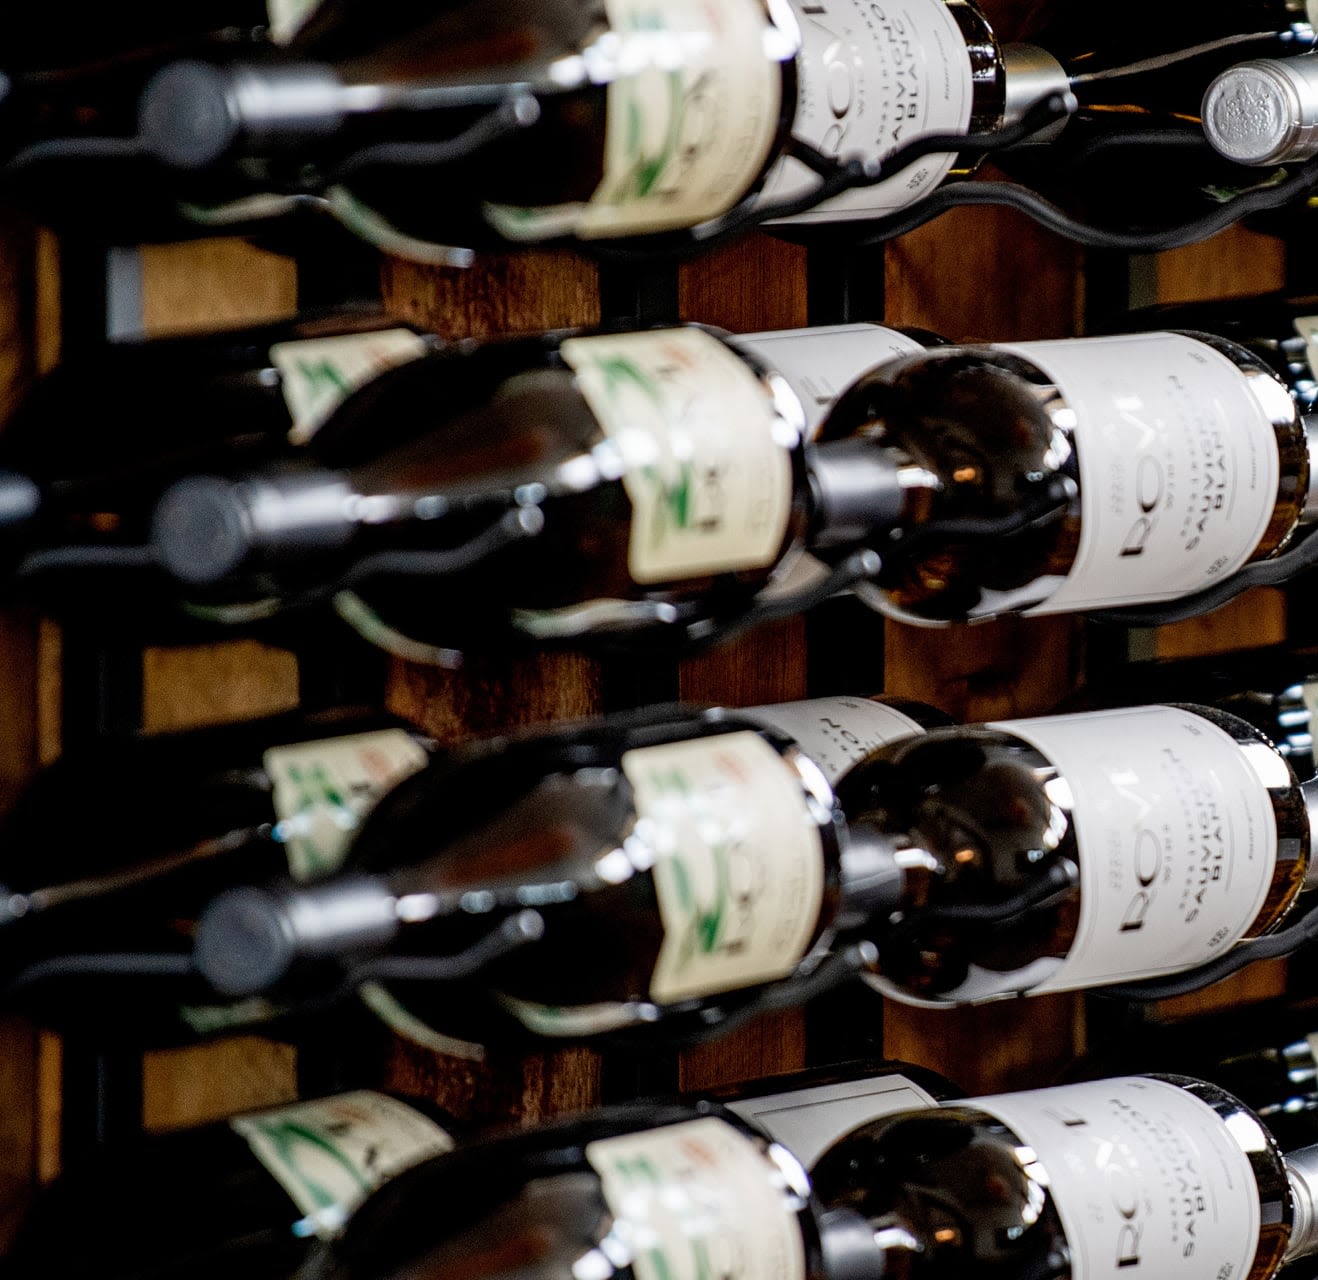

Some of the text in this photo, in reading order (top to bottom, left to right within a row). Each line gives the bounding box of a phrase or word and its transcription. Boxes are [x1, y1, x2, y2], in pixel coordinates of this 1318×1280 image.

[890, 18, 919, 119] BLANC
[1112, 394, 1165, 560] ROV
[1167, 375, 1214, 552] SAUVIGNN
[1208, 416, 1227, 511] BLAN
[1104, 764, 1162, 934] ROV
